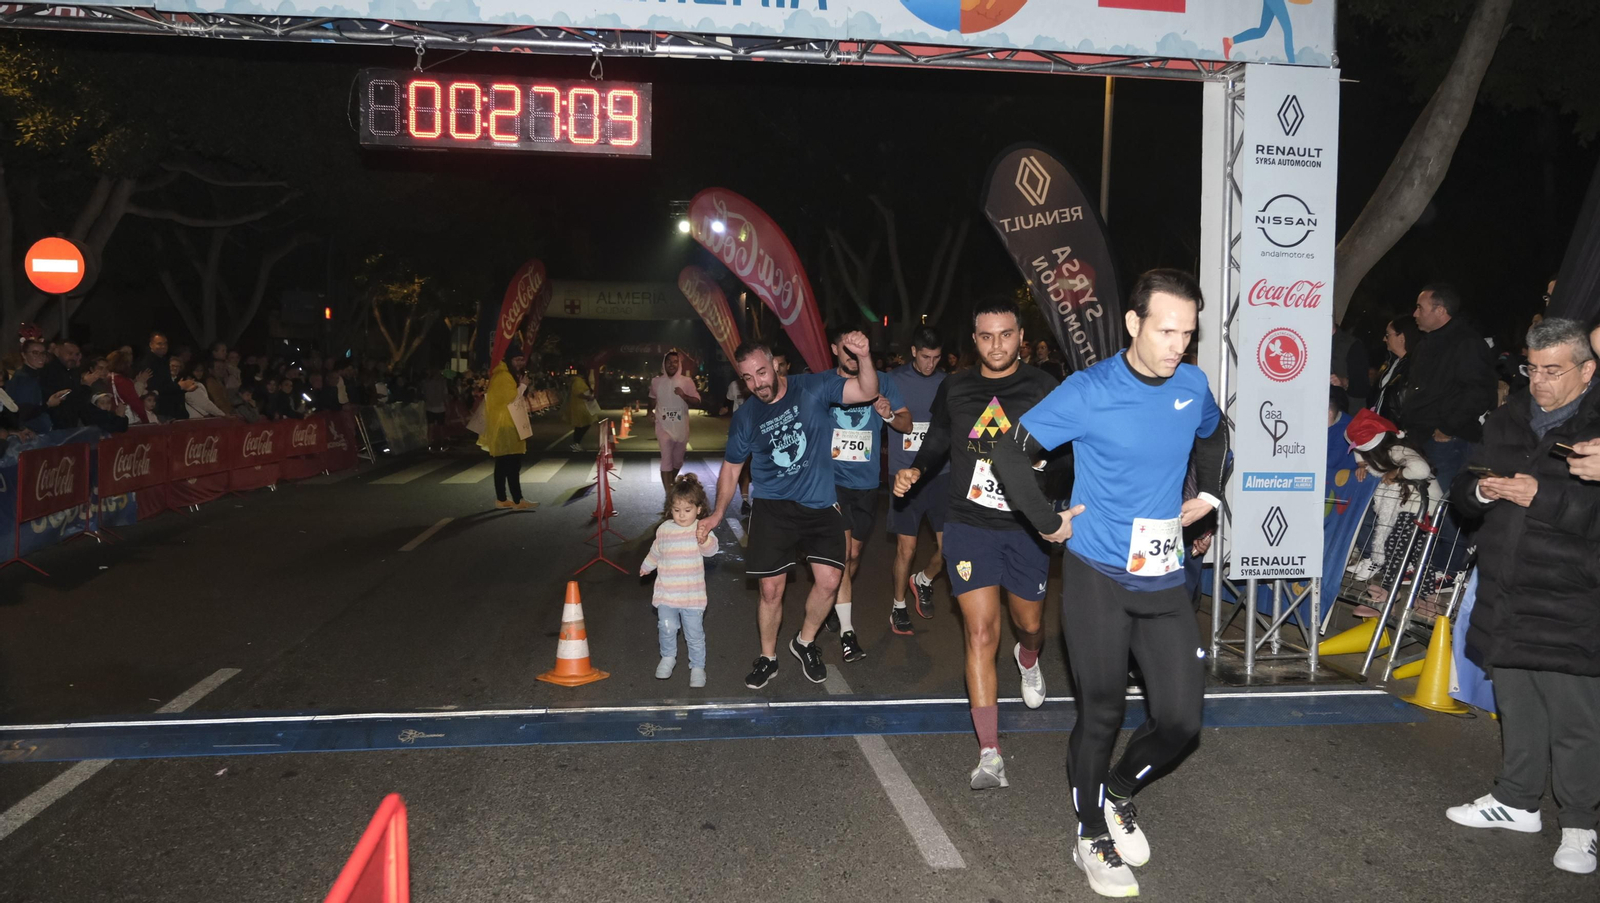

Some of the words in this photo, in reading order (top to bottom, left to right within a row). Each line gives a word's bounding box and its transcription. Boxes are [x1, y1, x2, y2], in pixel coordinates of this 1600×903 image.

[408, 80, 640, 147] 00:27:09
[1256, 144, 1322, 158] RENAULT
[1256, 157, 1276, 166] SYRSA
[1278, 158, 1322, 168] AUTOMOCION
[1255, 216, 1317, 226] NISSAN
[1260, 250, 1314, 259] andalmotor.es
[1248, 278, 1326, 308] Coca-Cola
[596, 306, 632, 315] CIUDAD
[912, 432, 926, 441] 76
[1273, 420, 1305, 458] Paquita
[841, 440, 864, 450] 750
[967, 440, 998, 454] ALT
[984, 480, 1006, 495] 38
[1246, 476, 1293, 488] Almericar
[1149, 536, 1178, 556] 364
[1241, 556, 1306, 566] RENAULT
